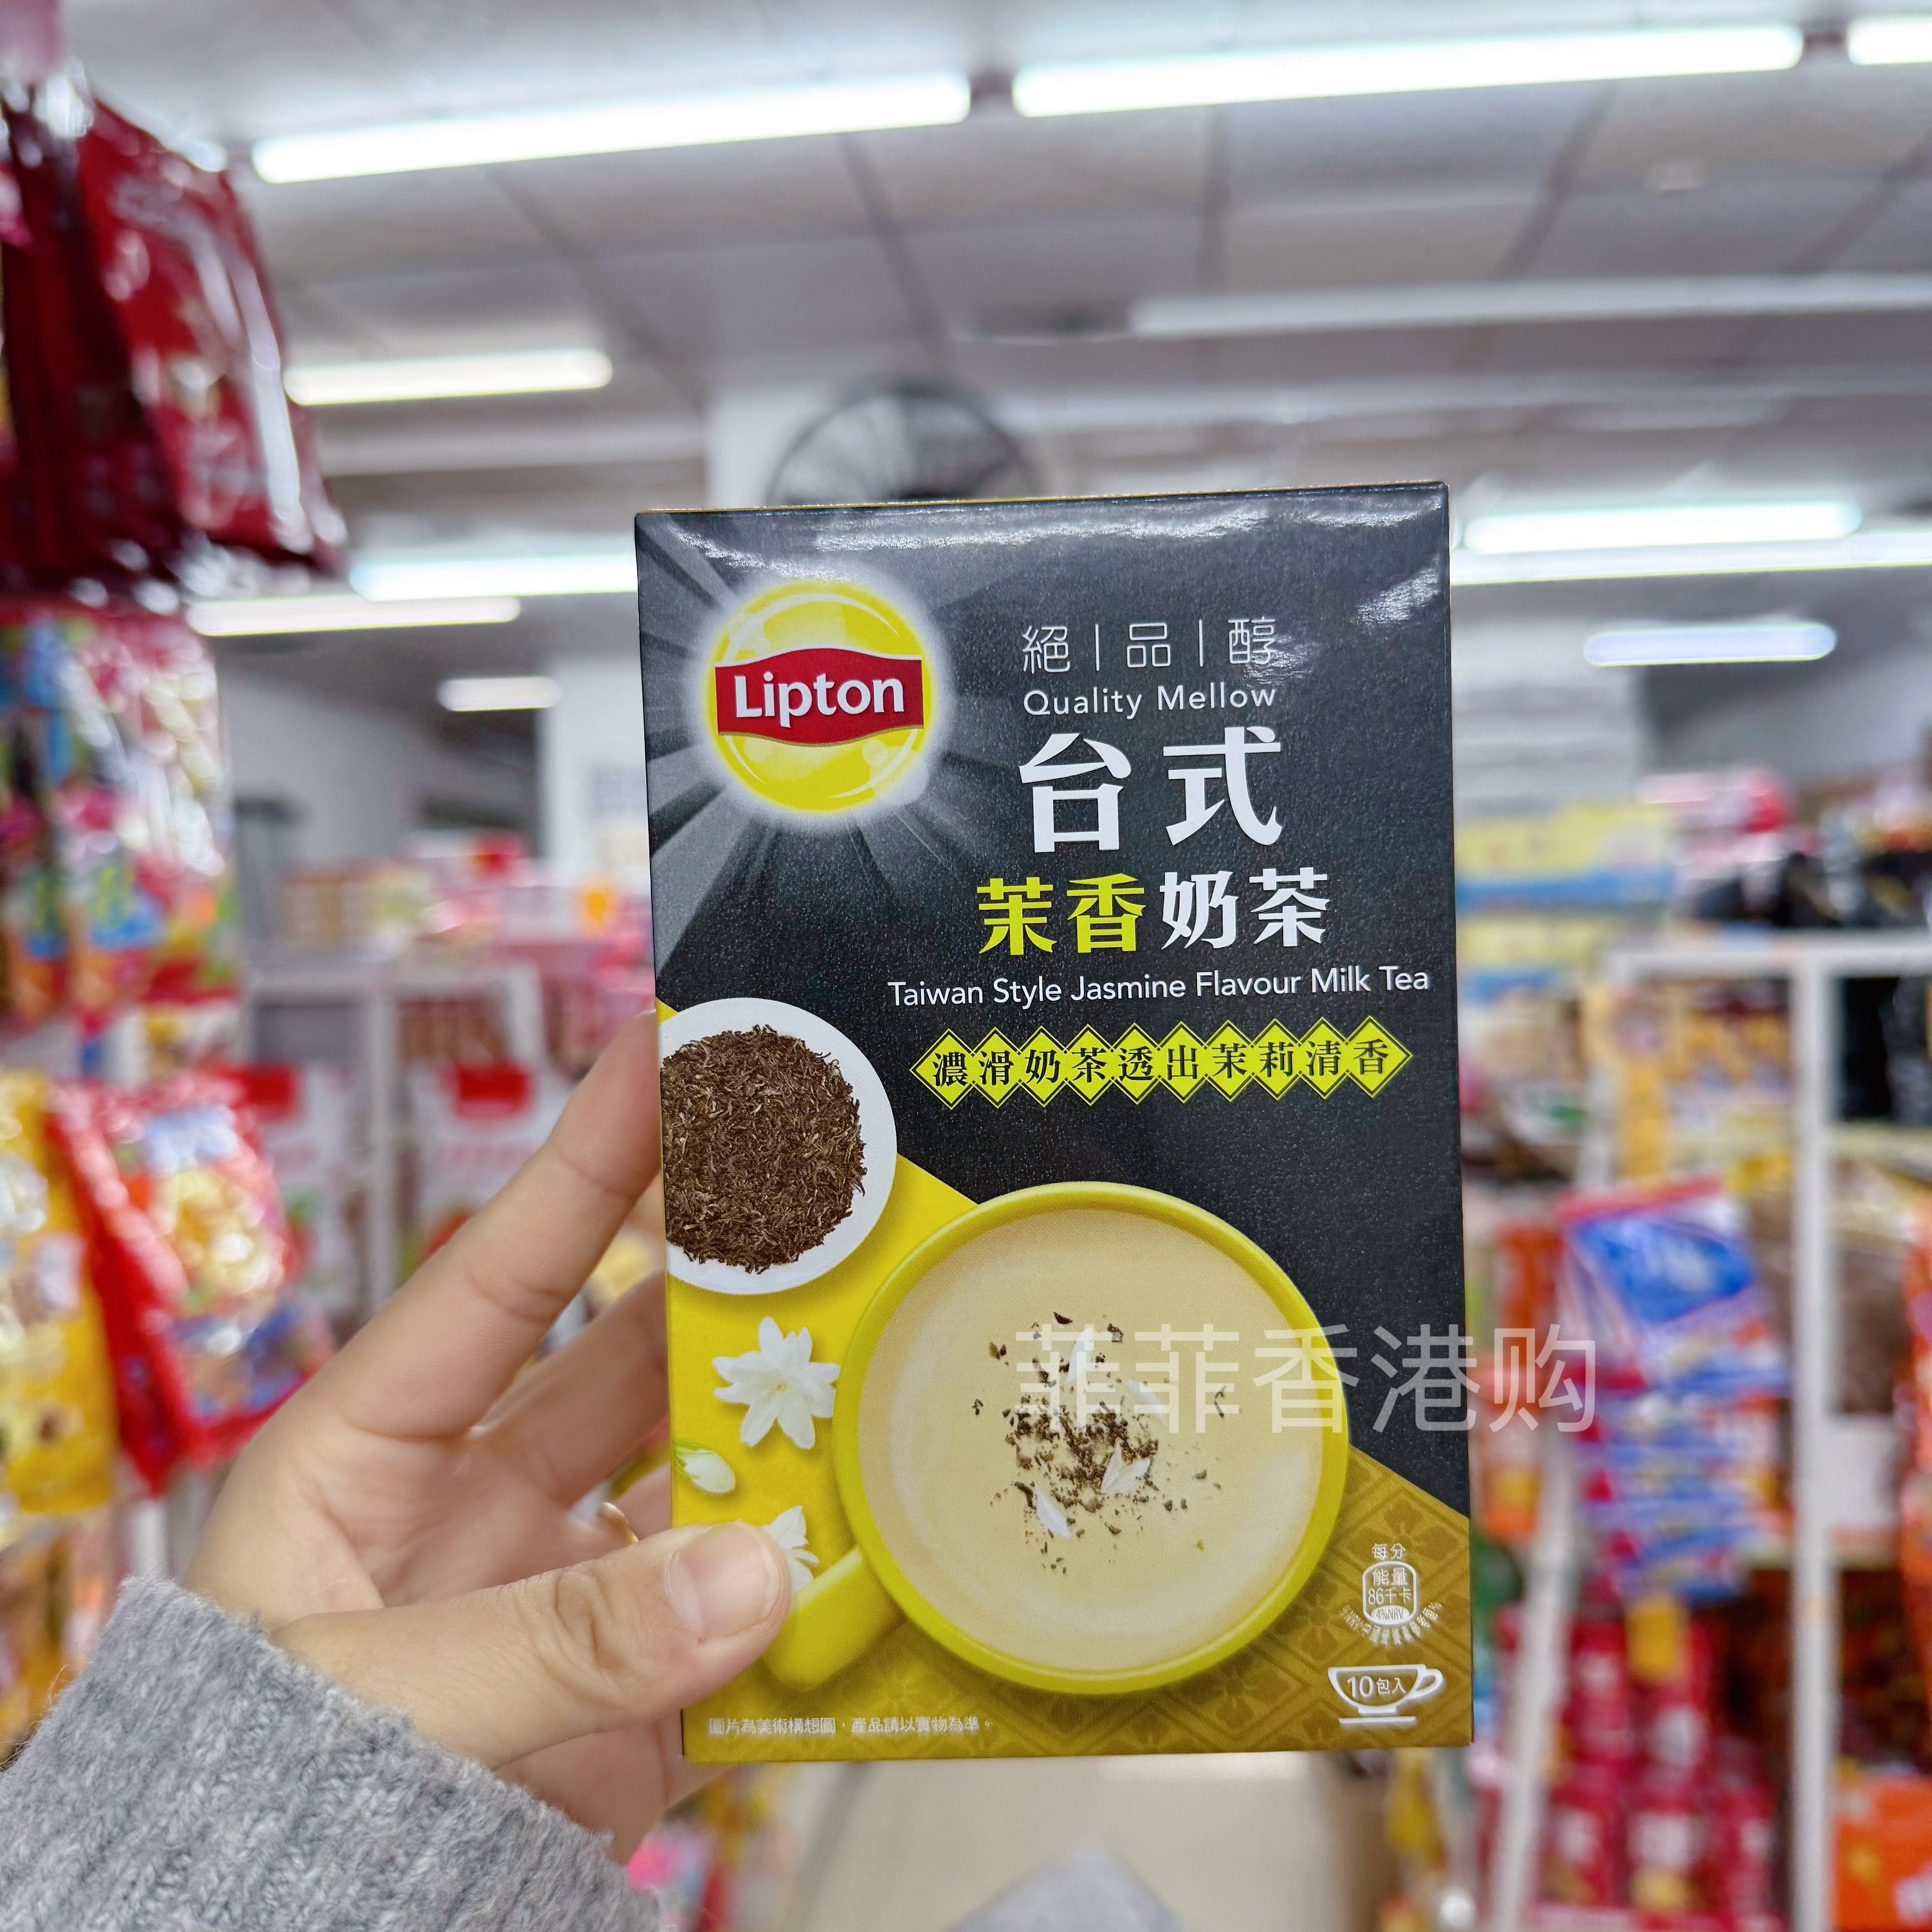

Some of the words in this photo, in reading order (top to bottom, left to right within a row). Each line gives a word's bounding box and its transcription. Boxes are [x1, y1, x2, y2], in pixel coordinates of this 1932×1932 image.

[734, 671, 905, 728] Lipton
[1024, 687, 1142, 720] Quality
[1158, 681, 1276, 711] Mellow
[1019, 726, 1283, 853] 台式
[977, 867, 1330, 955] 茉香奶茶
[887, 980, 984, 1006] Taiwan
[994, 975, 1062, 1010] Style
[1071, 974, 1186, 1001] Jasmine
[1196, 969, 1302, 997] Flavour
[1311, 965, 1371, 993] Milk
[1379, 964, 1429, 991] Tea
[932, 1037, 1389, 1086] 濃滑奶茶透出茉莉清香
[1368, 1586, 1412, 1605] 86千卡
[1373, 1567, 1408, 1587] 能量
[1347, 1674, 1407, 1698] 10包入
